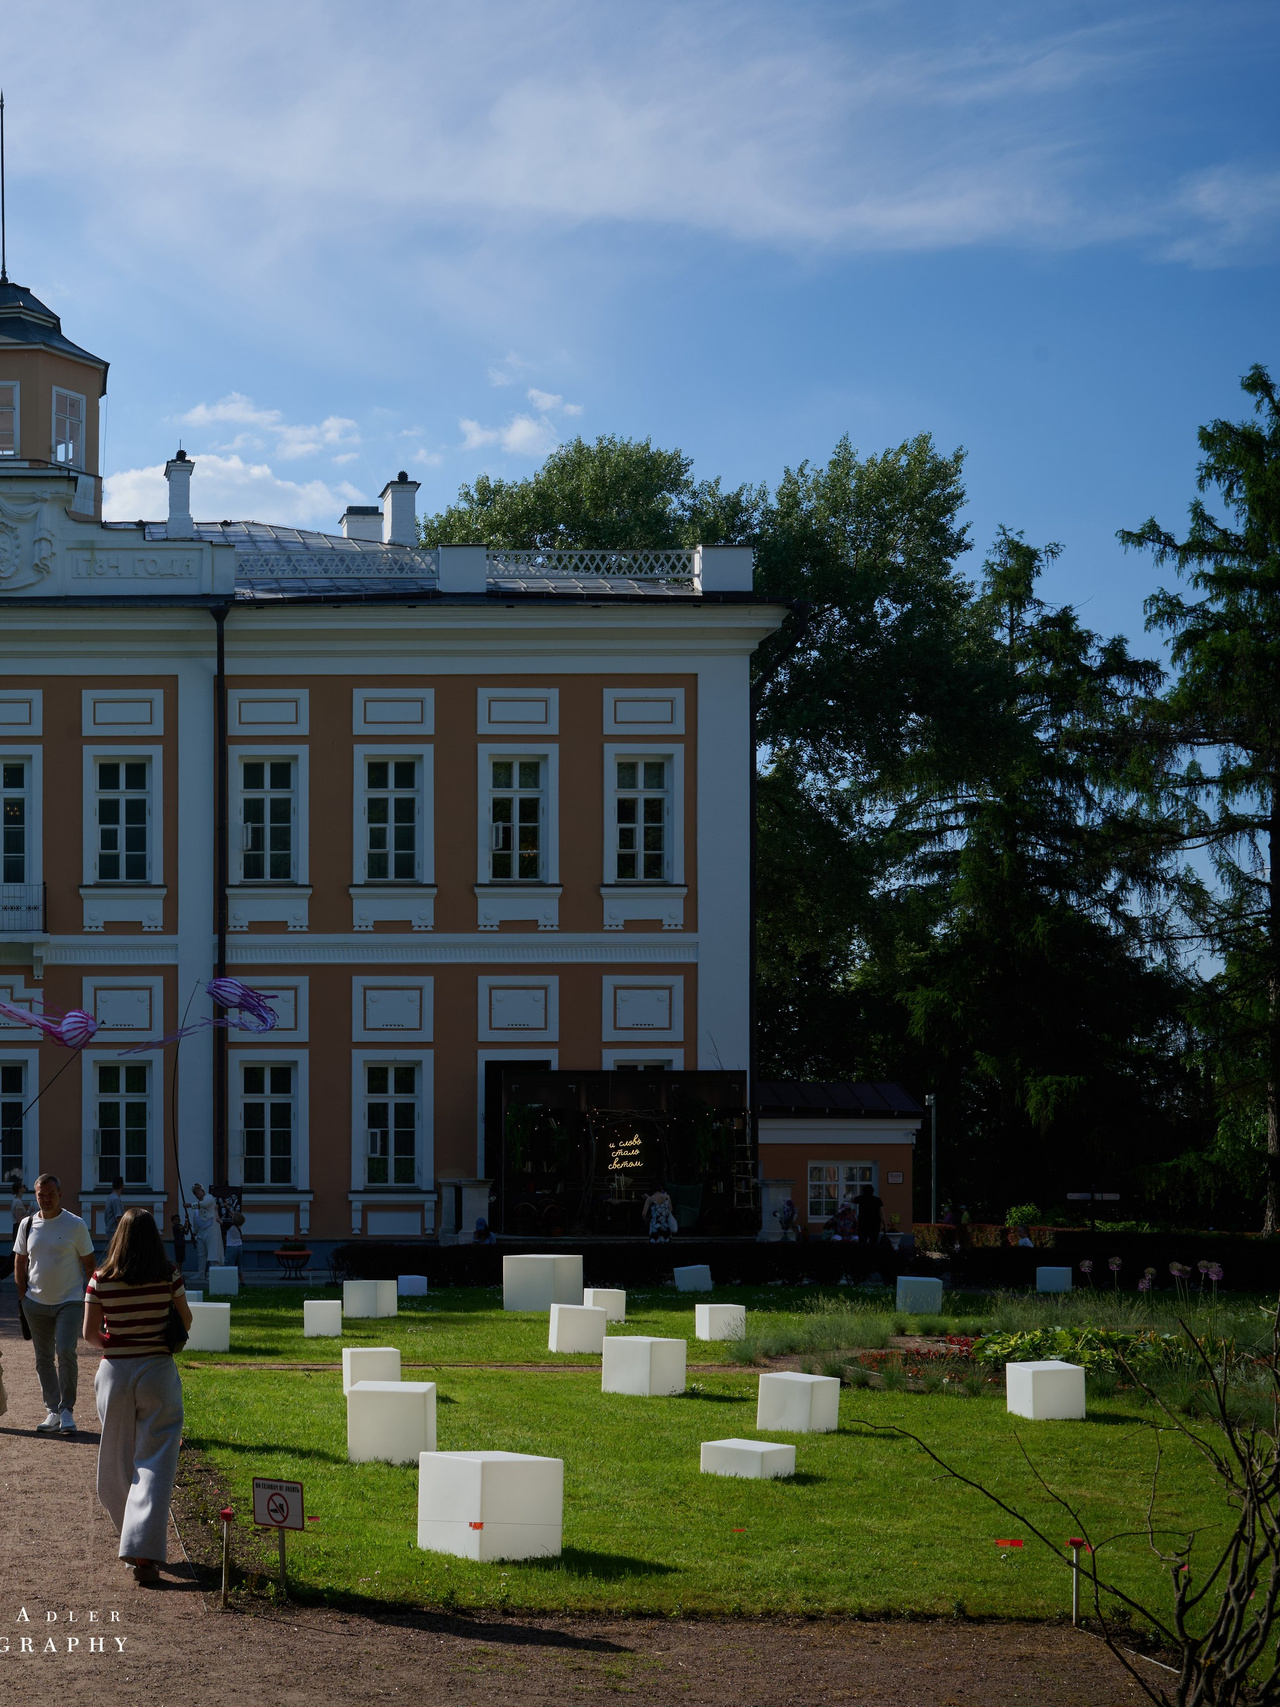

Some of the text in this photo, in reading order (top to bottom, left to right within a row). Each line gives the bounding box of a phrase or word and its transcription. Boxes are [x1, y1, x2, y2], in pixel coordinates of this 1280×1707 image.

[76, 557, 194, 577] 1784 ГОДА
[618, 1133, 643, 1147] слово
[611, 1148, 641, 1158] стало
[607, 1157, 645, 1170] светом
